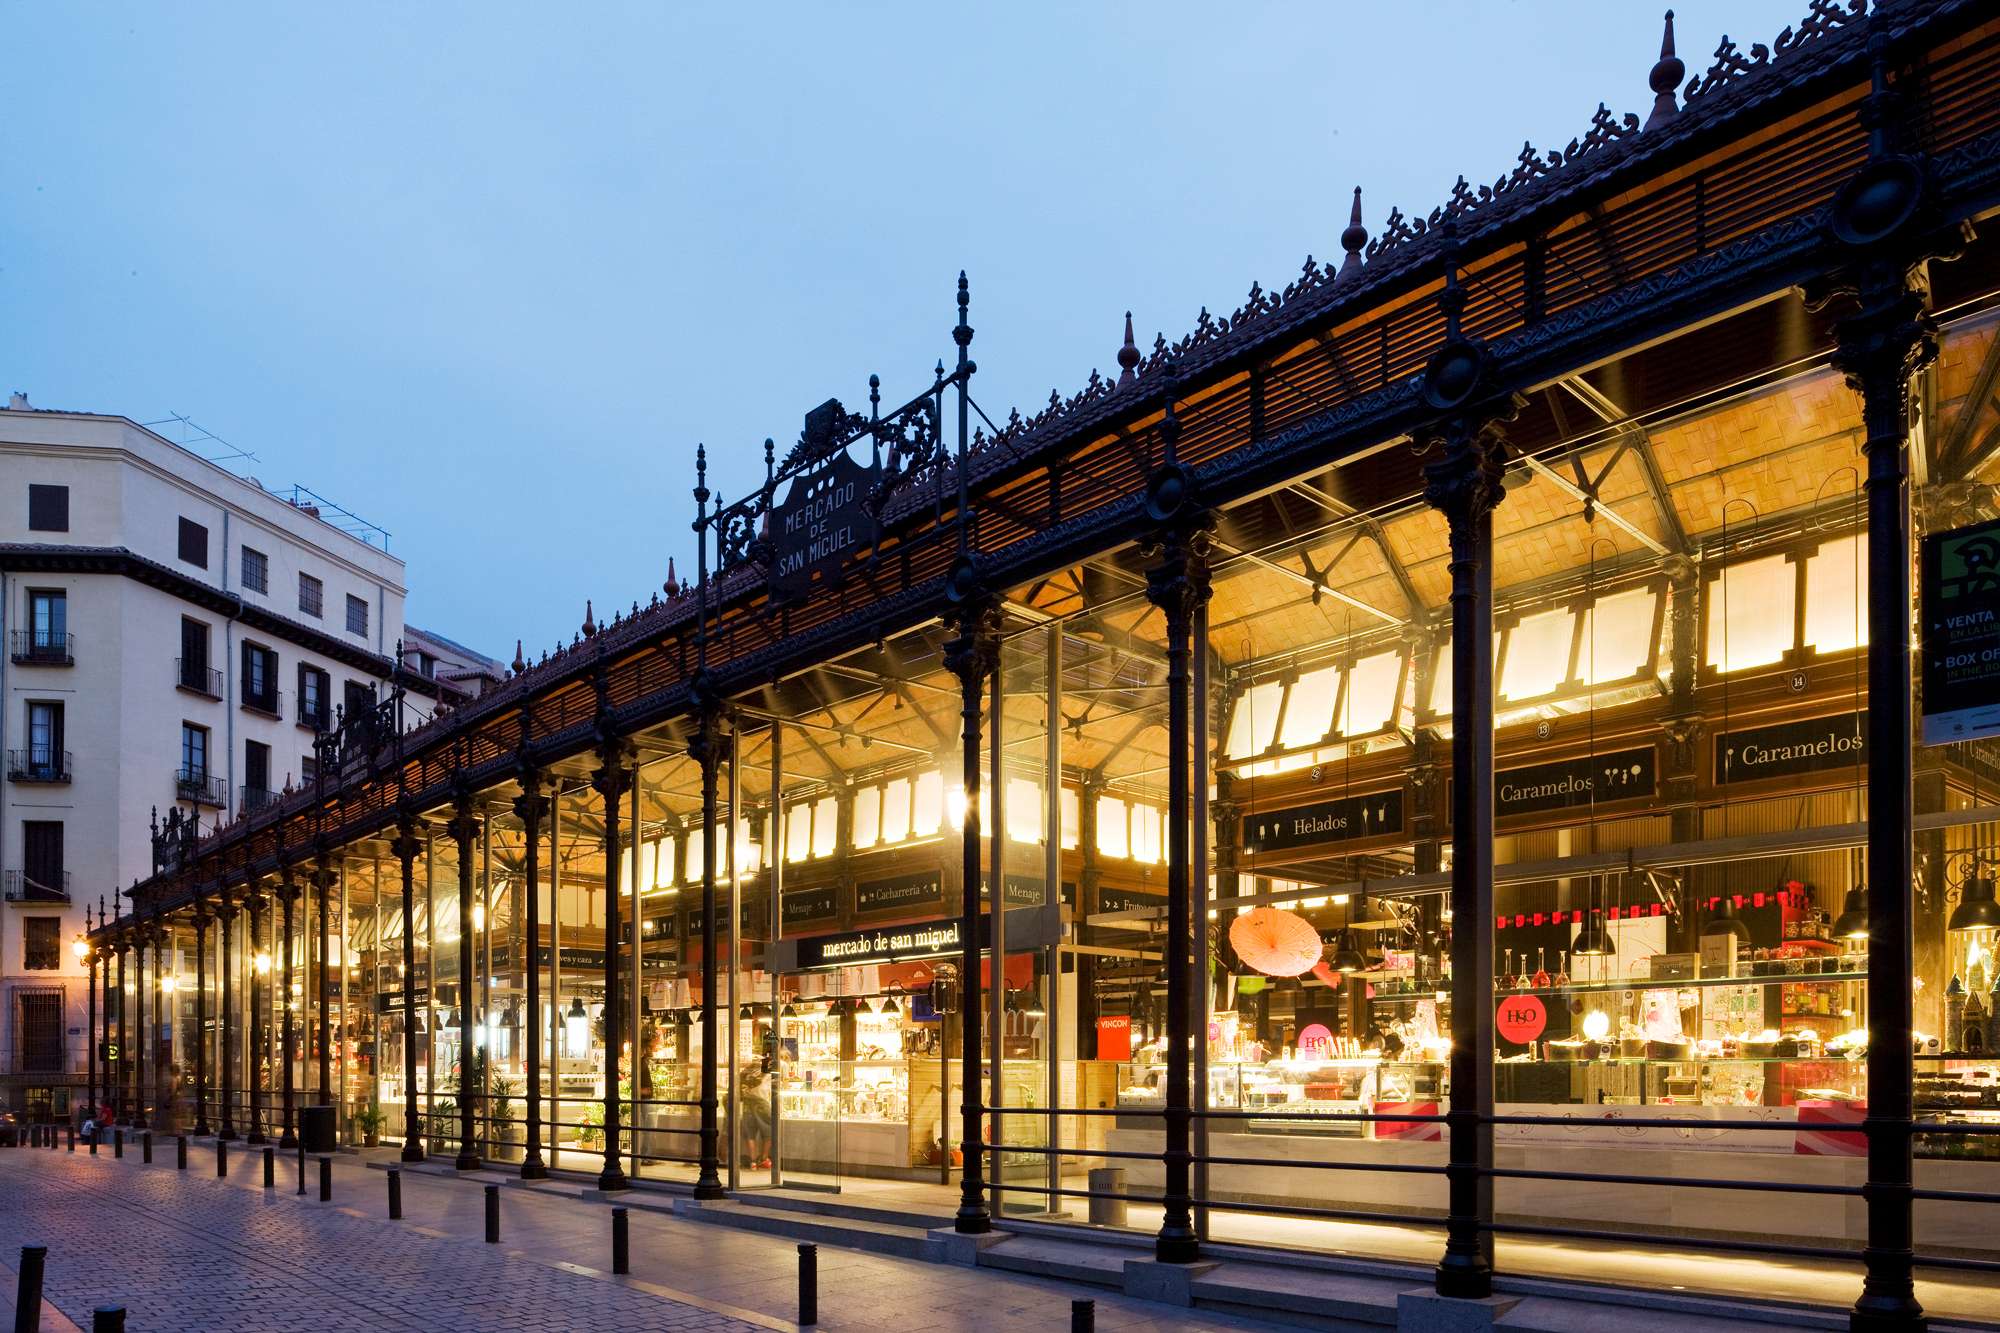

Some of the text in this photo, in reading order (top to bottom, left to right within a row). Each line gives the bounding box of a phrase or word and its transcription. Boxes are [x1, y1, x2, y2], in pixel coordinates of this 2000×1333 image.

[785, 482, 854, 535] MERCADO
[810, 518, 828, 538] DE
[779, 525, 856, 577] SAN MIGUEL
[1946, 609, 1995, 629] VENTA
[1945, 651, 1977, 669] BOX
[1794, 677, 1803, 687] 14
[1742, 733, 1863, 765] Caramelos
[1501, 775, 1594, 802] Caramelos
[1294, 815, 1348, 836] Helados
[1009, 884, 1041, 902] Menaje
[823, 922, 959, 957] mercado de san miguel
